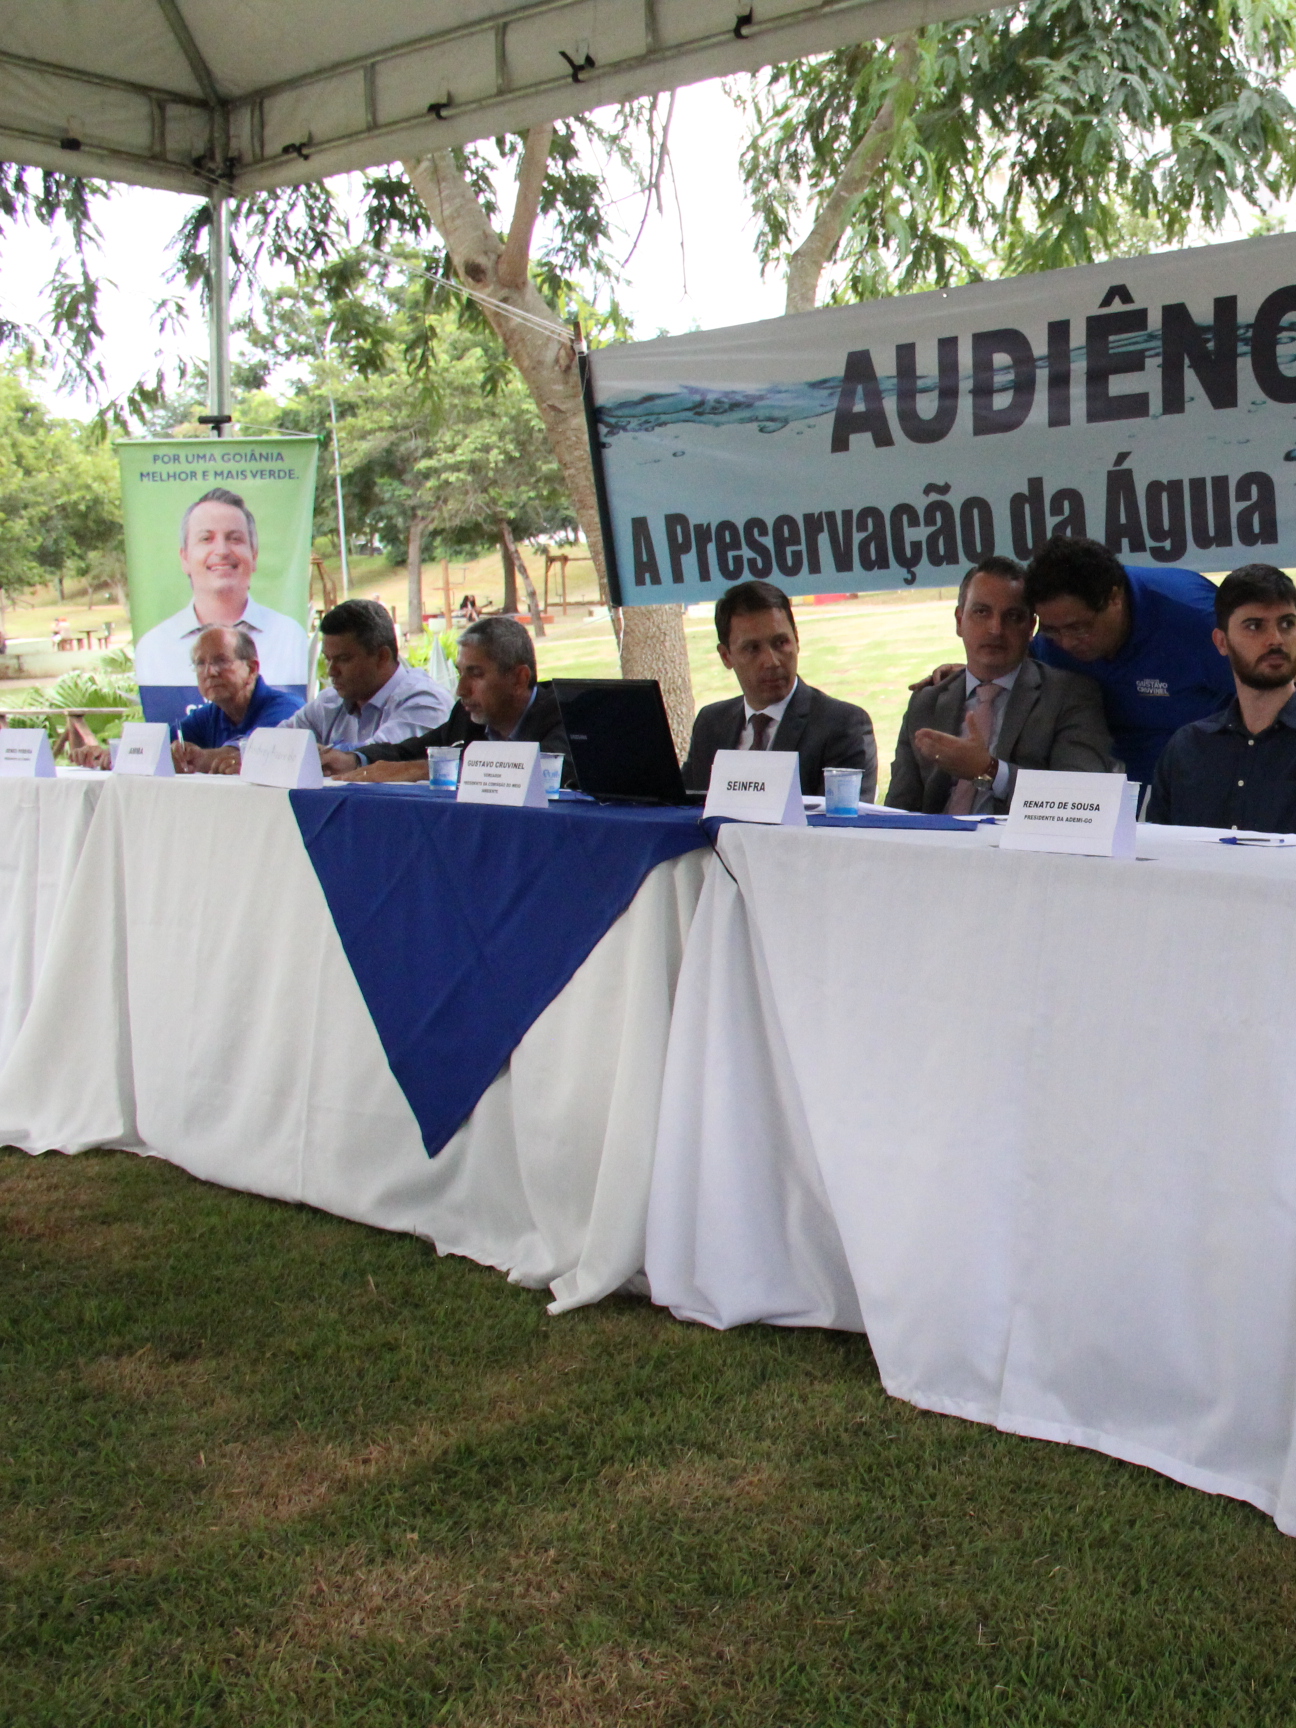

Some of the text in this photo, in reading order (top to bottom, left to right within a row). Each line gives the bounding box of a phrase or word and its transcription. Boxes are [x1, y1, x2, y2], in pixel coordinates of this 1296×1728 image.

[153, 449, 285, 464] POR UMA GOIÂNIA
[140, 469, 299, 482] MELHOR E MAIS VERDE.
[631, 516, 662, 587] A
[664, 481, 996, 586] Preservação
[1010, 477, 1088, 561] da
[1104, 451, 1279, 563] Água
[467, 760, 525, 770] GUSTAVO CRUVINEL
[726, 780, 765, 792] SEINFRA
[1023, 800, 1101, 812] RENATO DE SOUSA
[1023, 814, 1055, 822] PRESIDENTE
